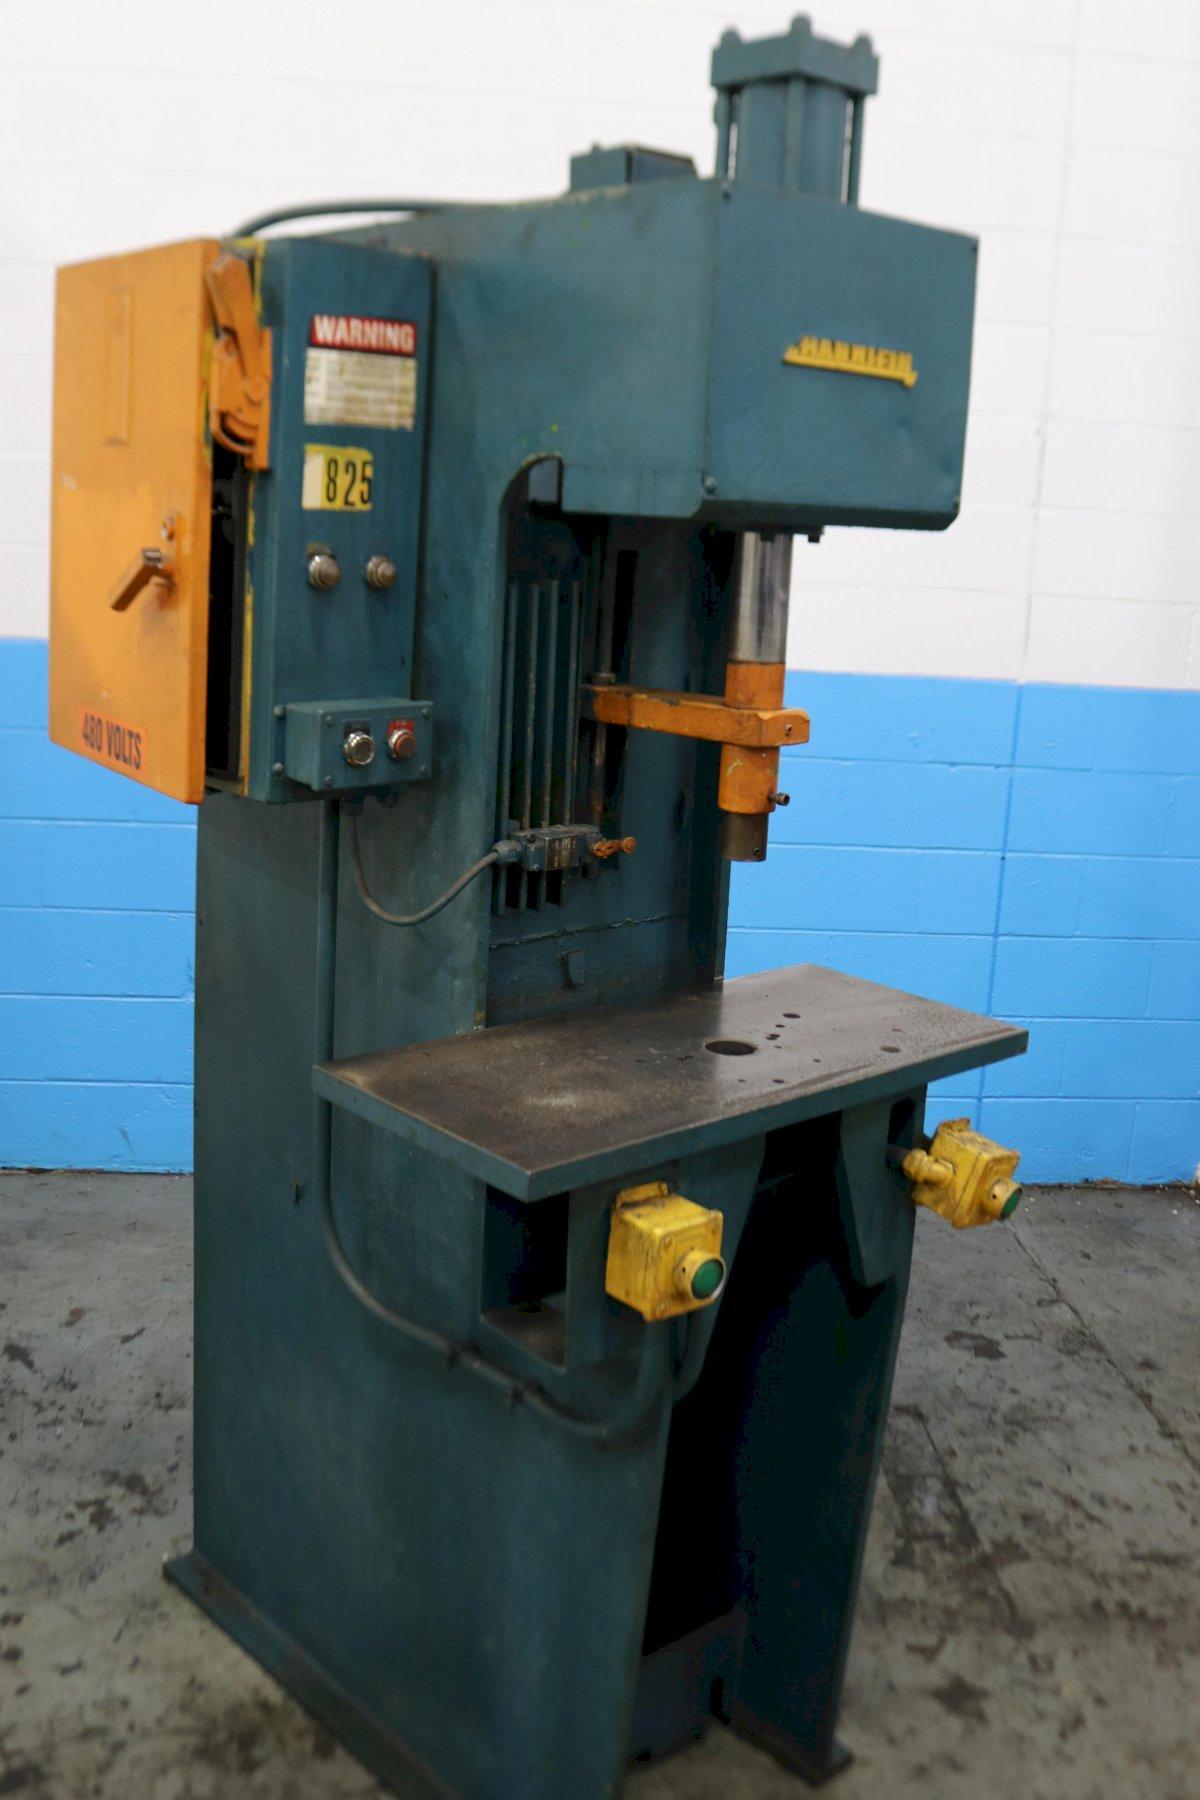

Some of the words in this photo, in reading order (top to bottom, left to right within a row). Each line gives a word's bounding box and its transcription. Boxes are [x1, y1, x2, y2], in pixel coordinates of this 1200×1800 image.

[312, 314, 415, 352] WARNING
[326, 458, 371, 507] 825
[83, 712, 103, 753] 480
[106, 720, 142, 771] VOLTS
